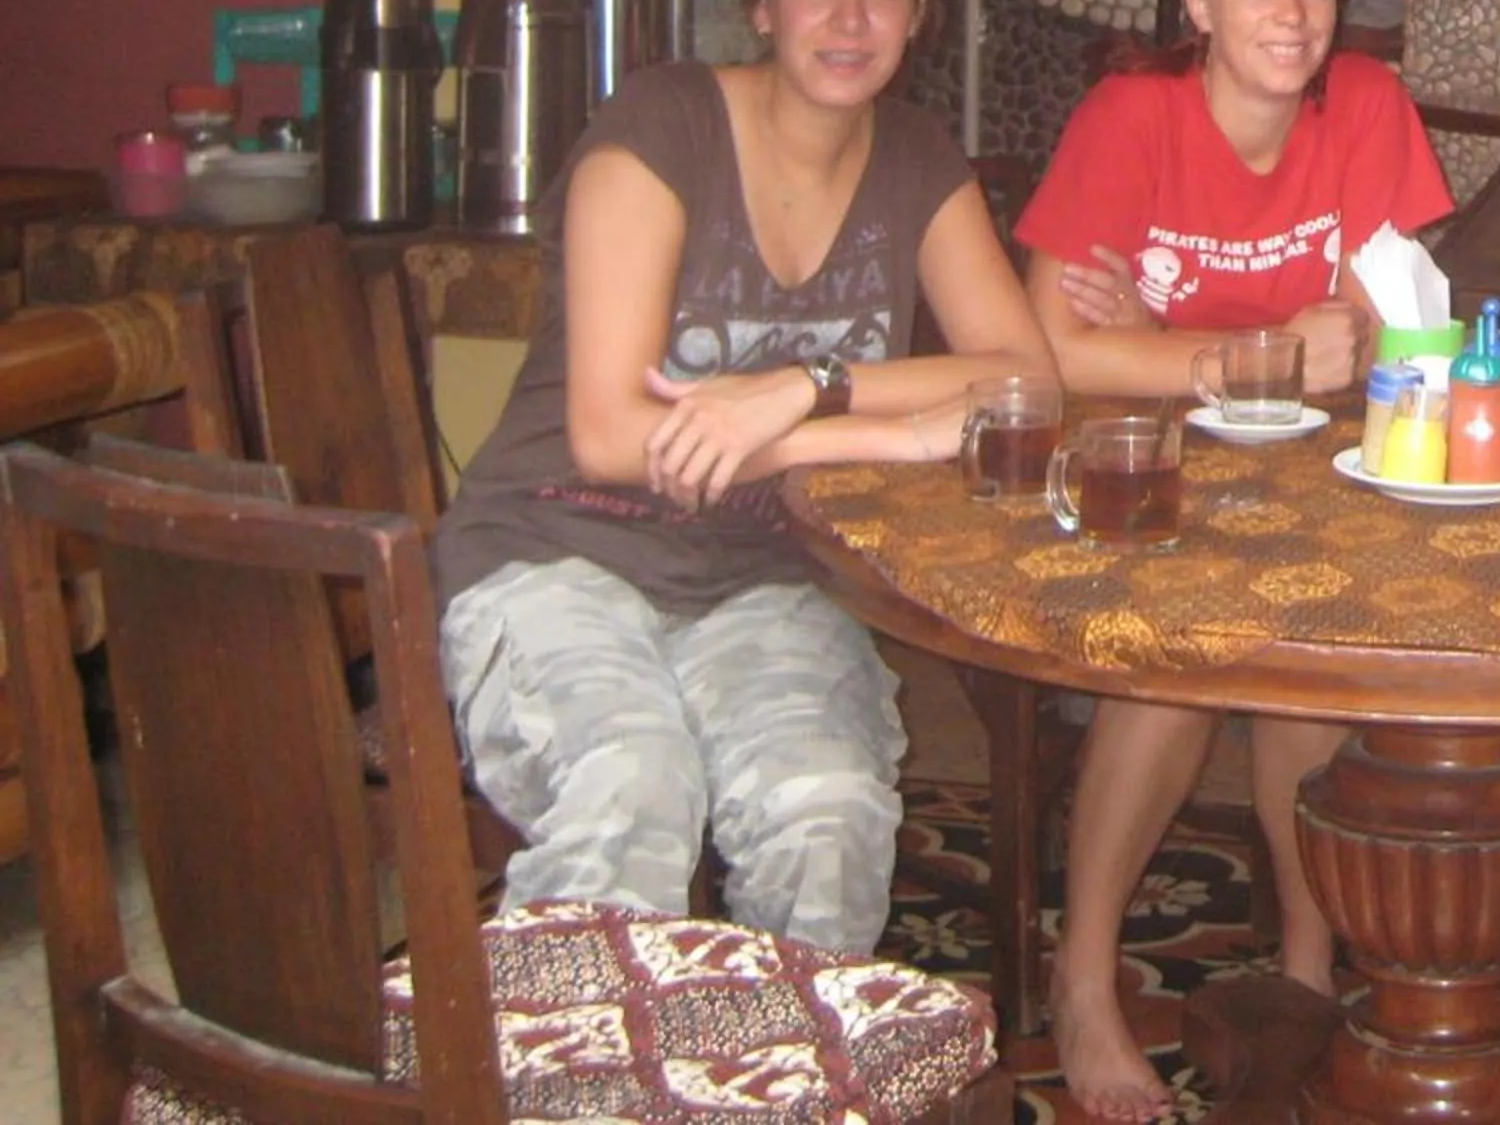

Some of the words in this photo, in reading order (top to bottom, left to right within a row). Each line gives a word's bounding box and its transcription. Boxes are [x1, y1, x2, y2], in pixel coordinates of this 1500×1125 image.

[1147, 225, 1218, 253] PIRATES
[1220, 240, 1255, 257] ARE
[1198, 252, 1246, 273] THAN
